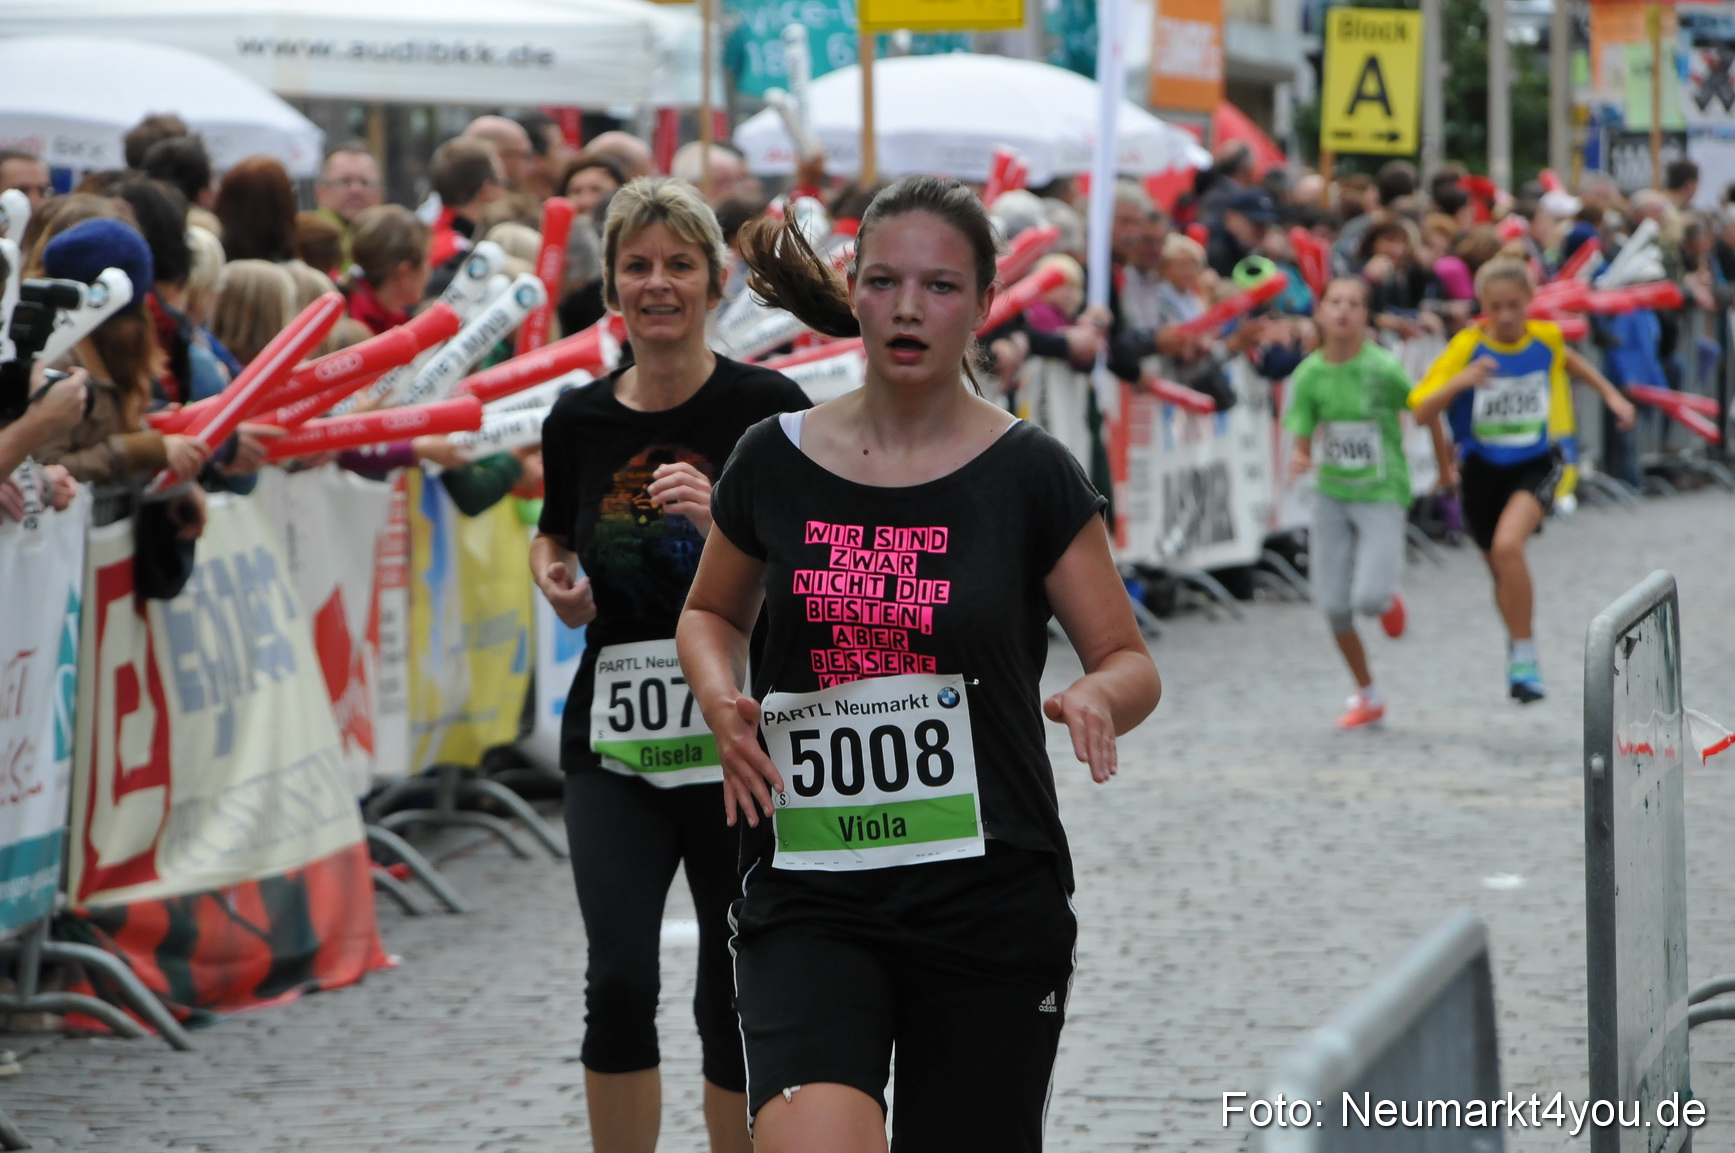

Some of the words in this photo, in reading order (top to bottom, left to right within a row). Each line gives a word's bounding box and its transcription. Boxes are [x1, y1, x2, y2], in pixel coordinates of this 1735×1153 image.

[1336, 12, 1408, 41] Block
[236, 36, 557, 69] www.audibkk.de
[1345, 54, 1394, 117] A
[807, 522, 861, 546] WIR
[876, 528, 946, 551] SIND
[832, 549, 914, 575] ZWAR
[794, 572, 884, 596] NICHT
[900, 580, 947, 601] DIE
[808, 600, 931, 633] BESTEN,
[835, 627, 906, 650] ABER
[599, 657, 642, 673] PARTL
[813, 651, 935, 674] BESSERE
[763, 704, 832, 727] PARTL
[836, 693, 930, 716] Neumarkt
[640, 743, 703, 768] Gisela
[789, 718, 955, 798] 5008
[838, 812, 908, 843] Viola
